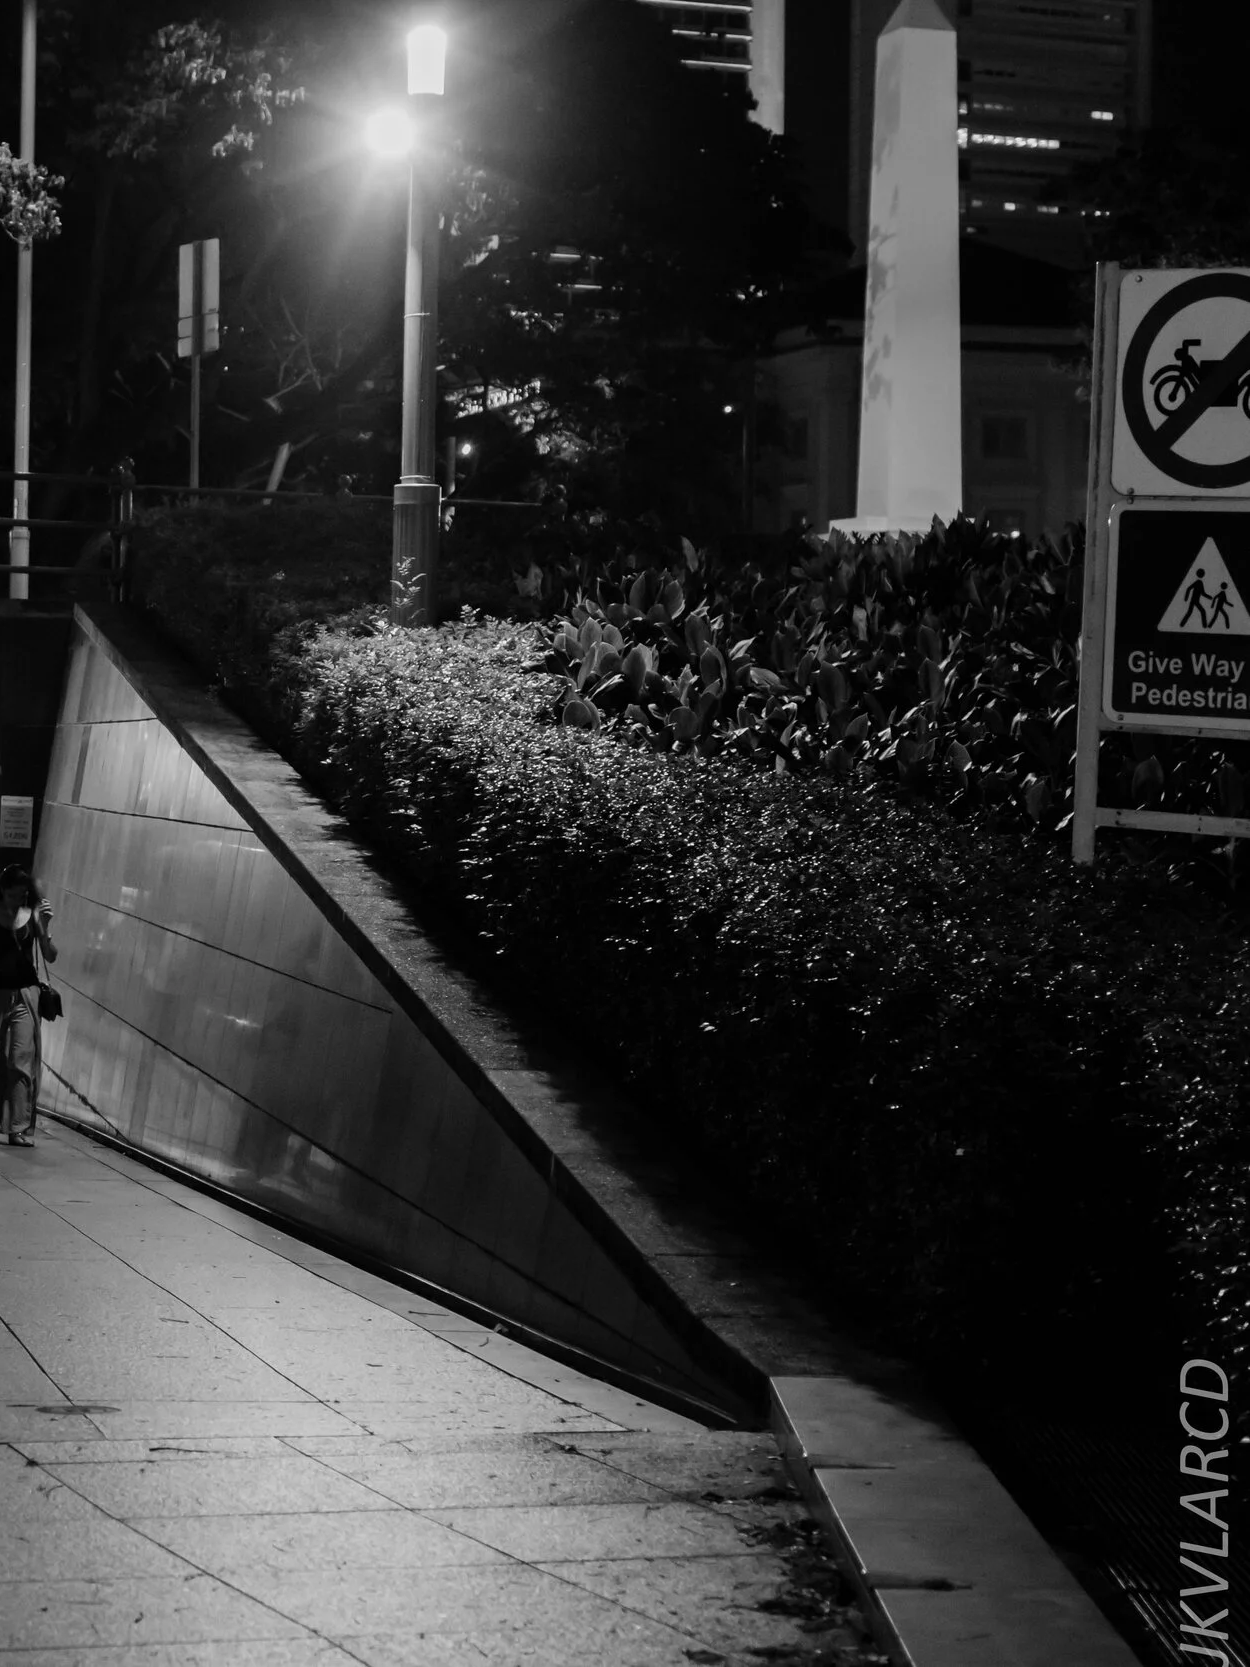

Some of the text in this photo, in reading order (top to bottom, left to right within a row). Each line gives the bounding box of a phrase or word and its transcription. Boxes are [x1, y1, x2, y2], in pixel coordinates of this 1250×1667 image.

[1128, 651, 1245, 683] Give Way
[1131, 682, 1250, 710] Pedestria
